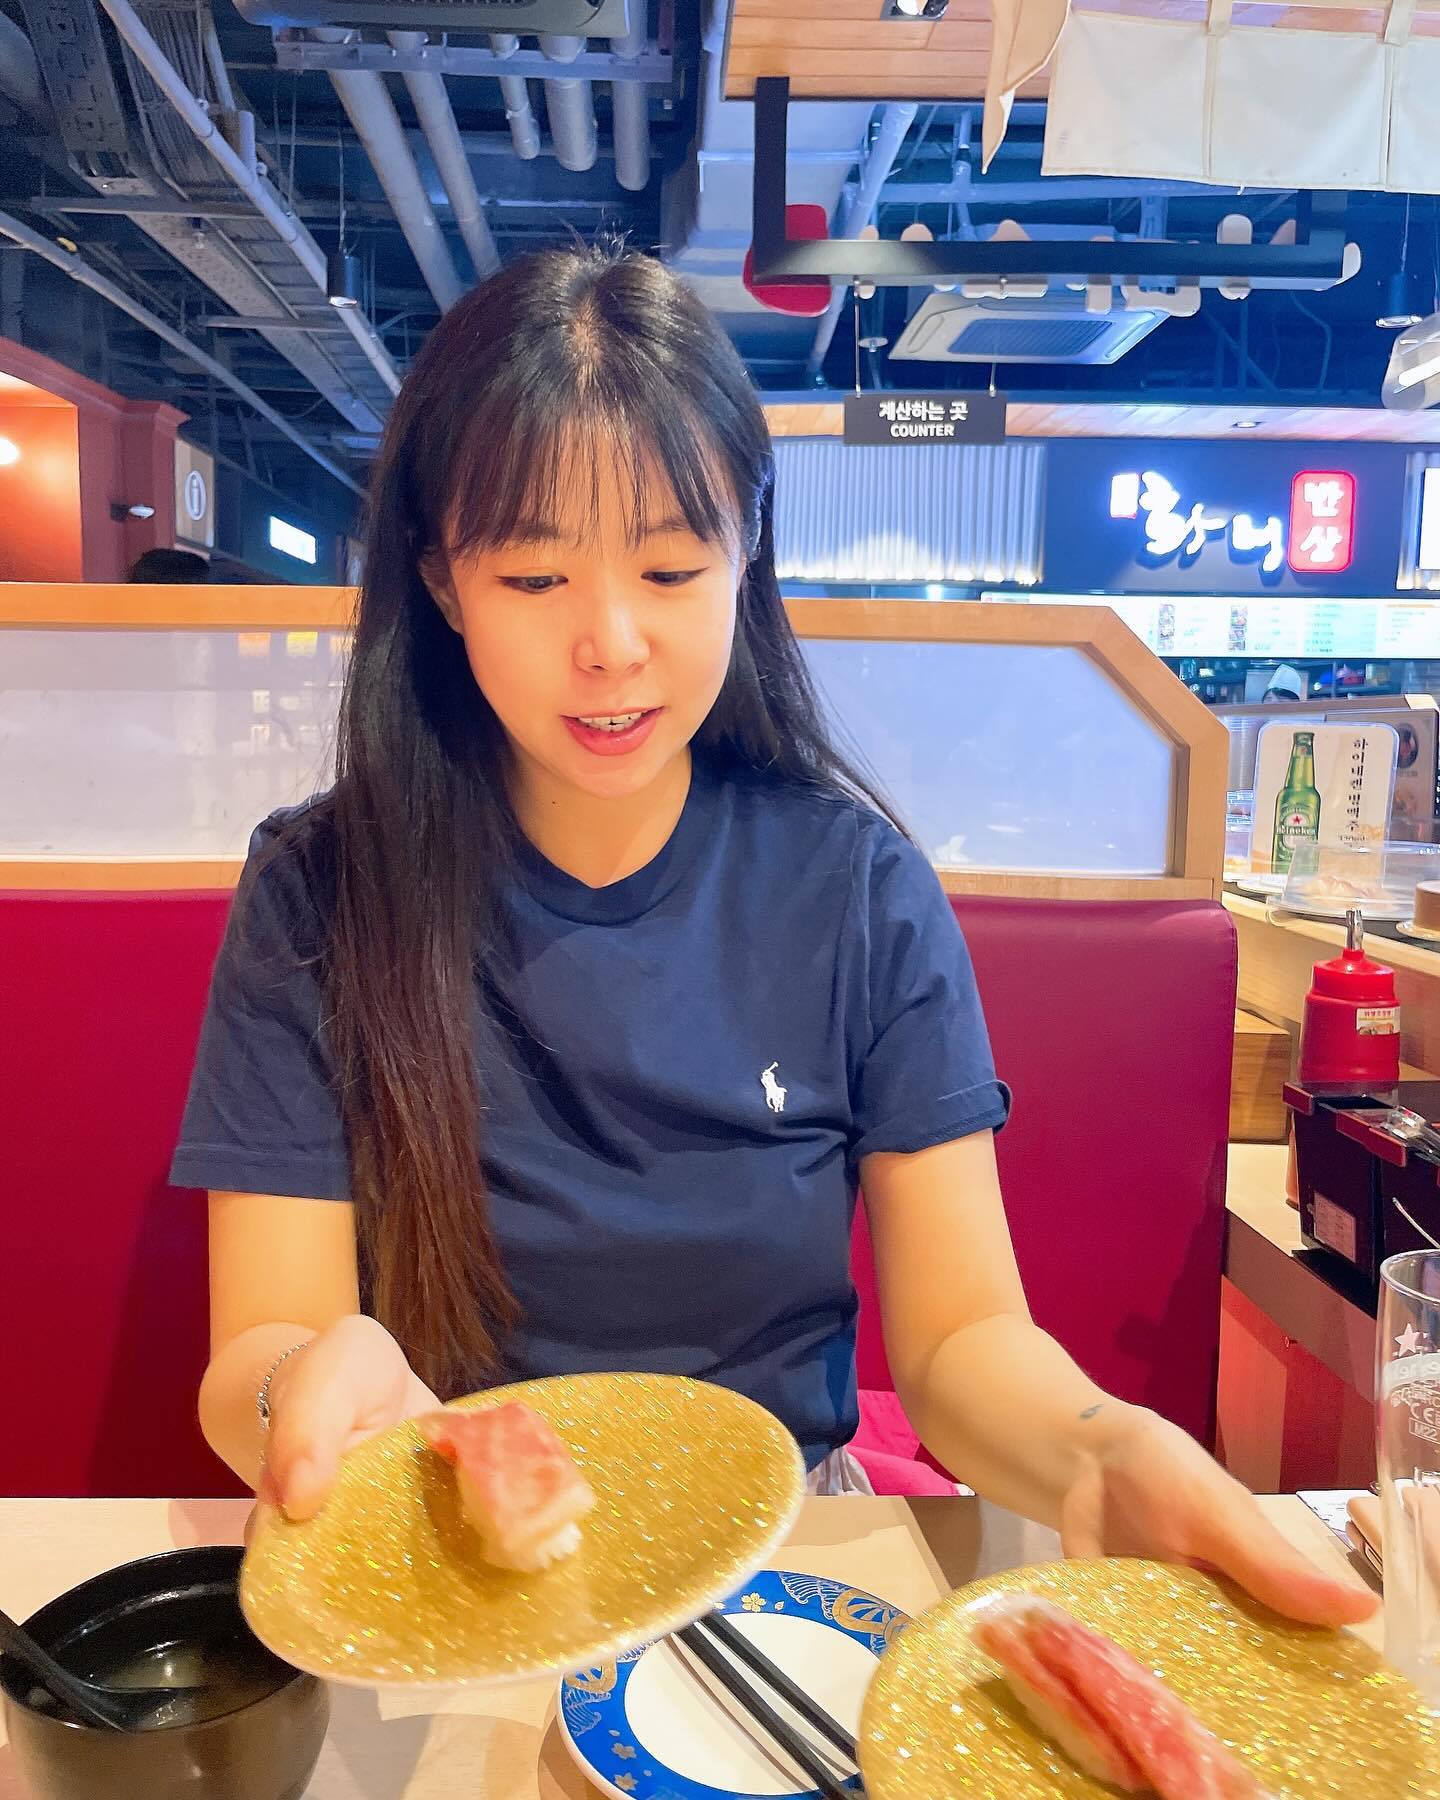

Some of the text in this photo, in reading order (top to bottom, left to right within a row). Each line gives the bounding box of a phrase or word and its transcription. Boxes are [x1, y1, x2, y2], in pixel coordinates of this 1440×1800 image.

[878, 400, 969, 421] 계산하는 곳
[890, 423, 955, 438] COUNTER
